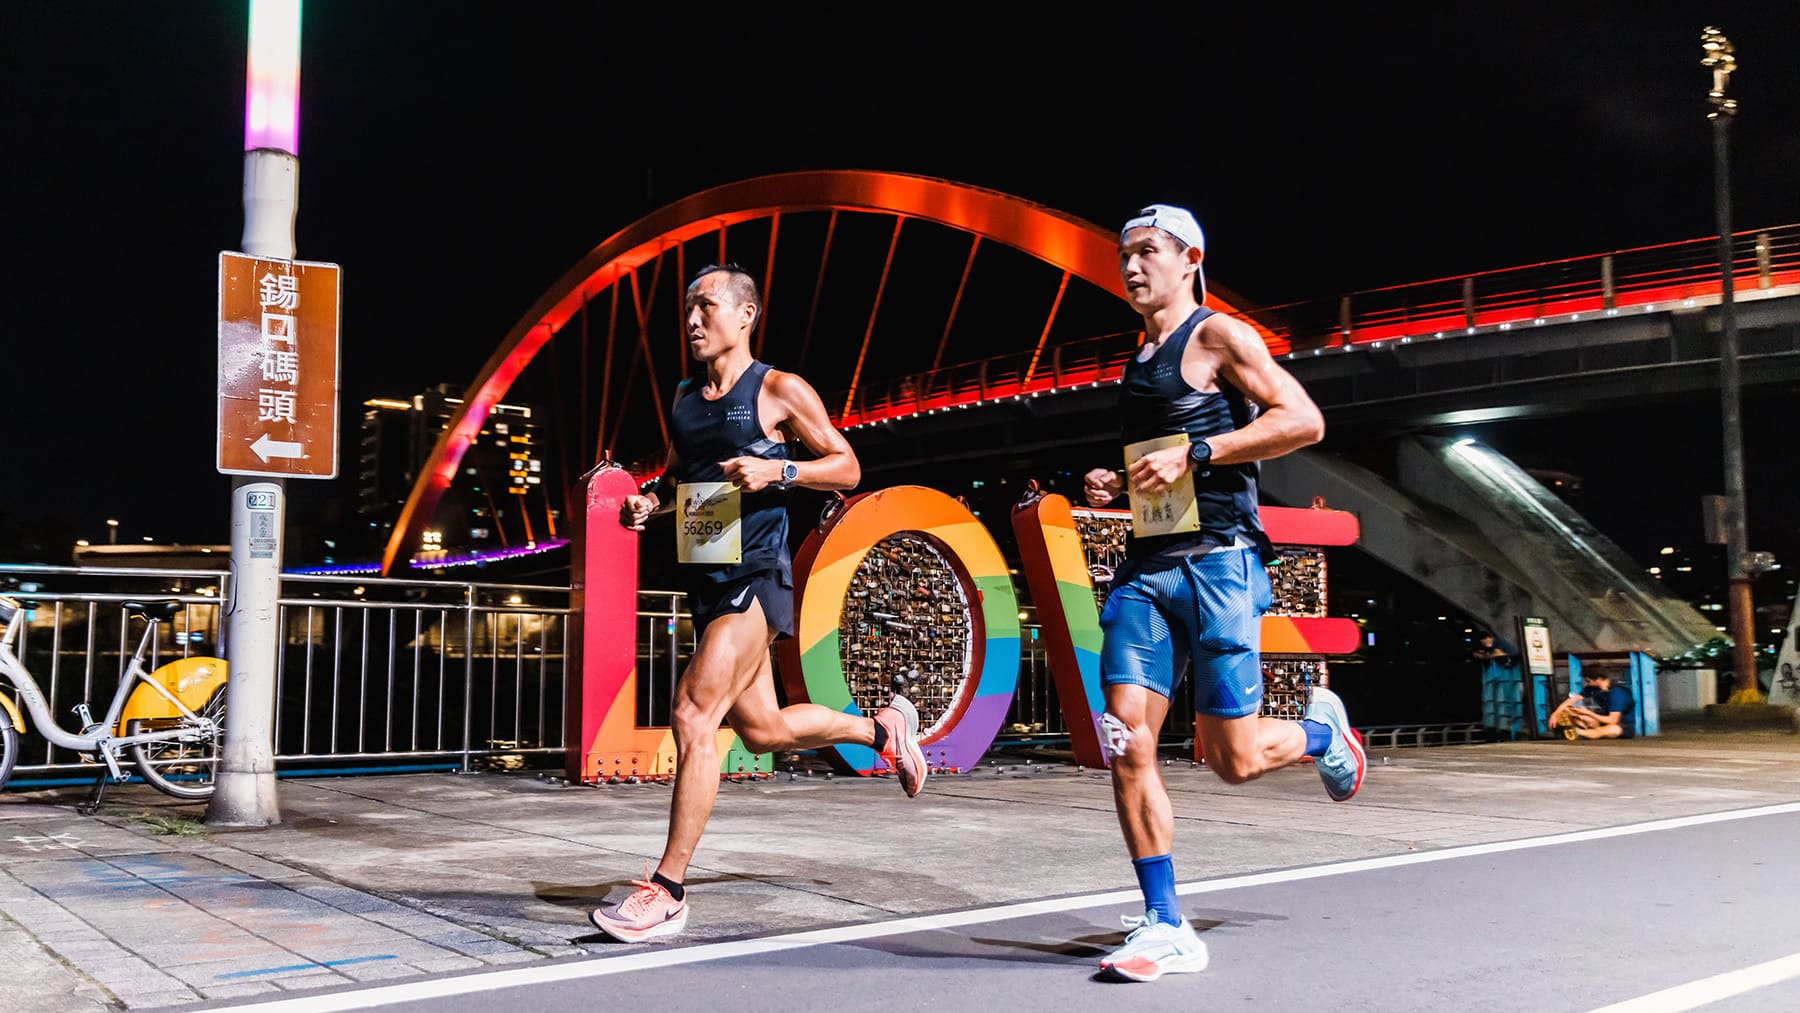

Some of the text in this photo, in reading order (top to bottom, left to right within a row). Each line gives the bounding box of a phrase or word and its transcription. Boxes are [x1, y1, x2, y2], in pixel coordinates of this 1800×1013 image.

[258, 272, 299, 425] 錫口碼頭
[248, 494, 274, 507] 221
[683, 520, 723, 536] 56269
